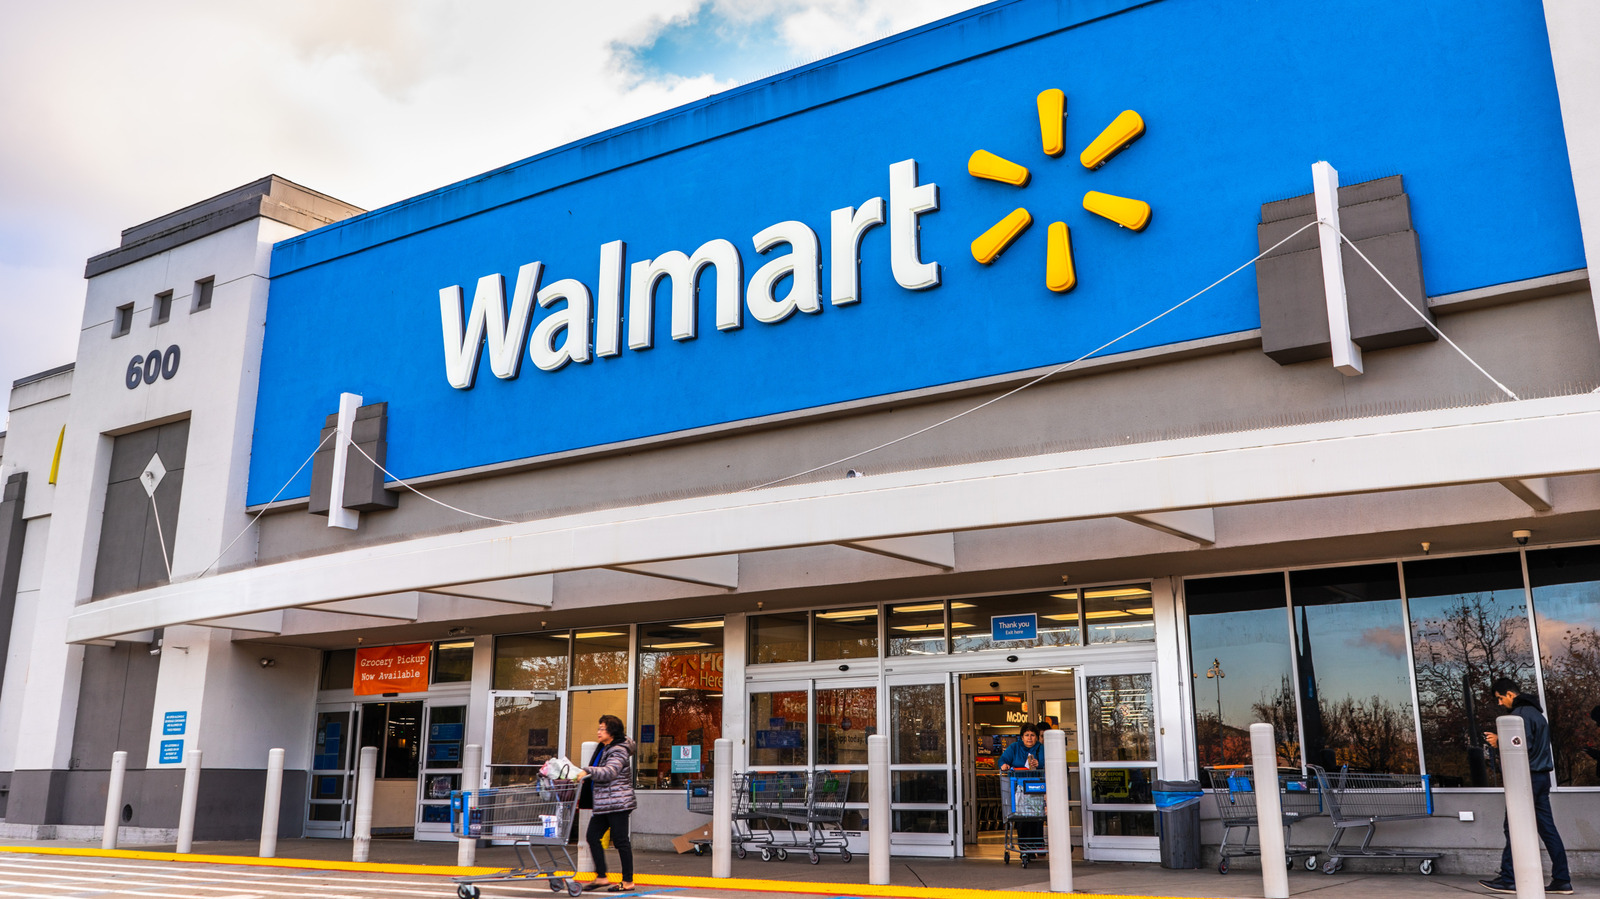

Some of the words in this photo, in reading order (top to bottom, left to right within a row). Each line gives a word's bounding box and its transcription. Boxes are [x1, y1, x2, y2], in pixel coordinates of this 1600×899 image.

[439, 158, 940, 390] Walmart
[126, 344, 180, 390] 600
[998, 621, 1017, 629] Thank
[1018, 621, 1030, 629] you
[361, 659, 393, 667] Grocery
[397, 655, 426, 664] Pickup
[378, 669, 420, 679] Available
[699, 670, 724, 688] Here
[1006, 711, 1042, 723] McDon's
